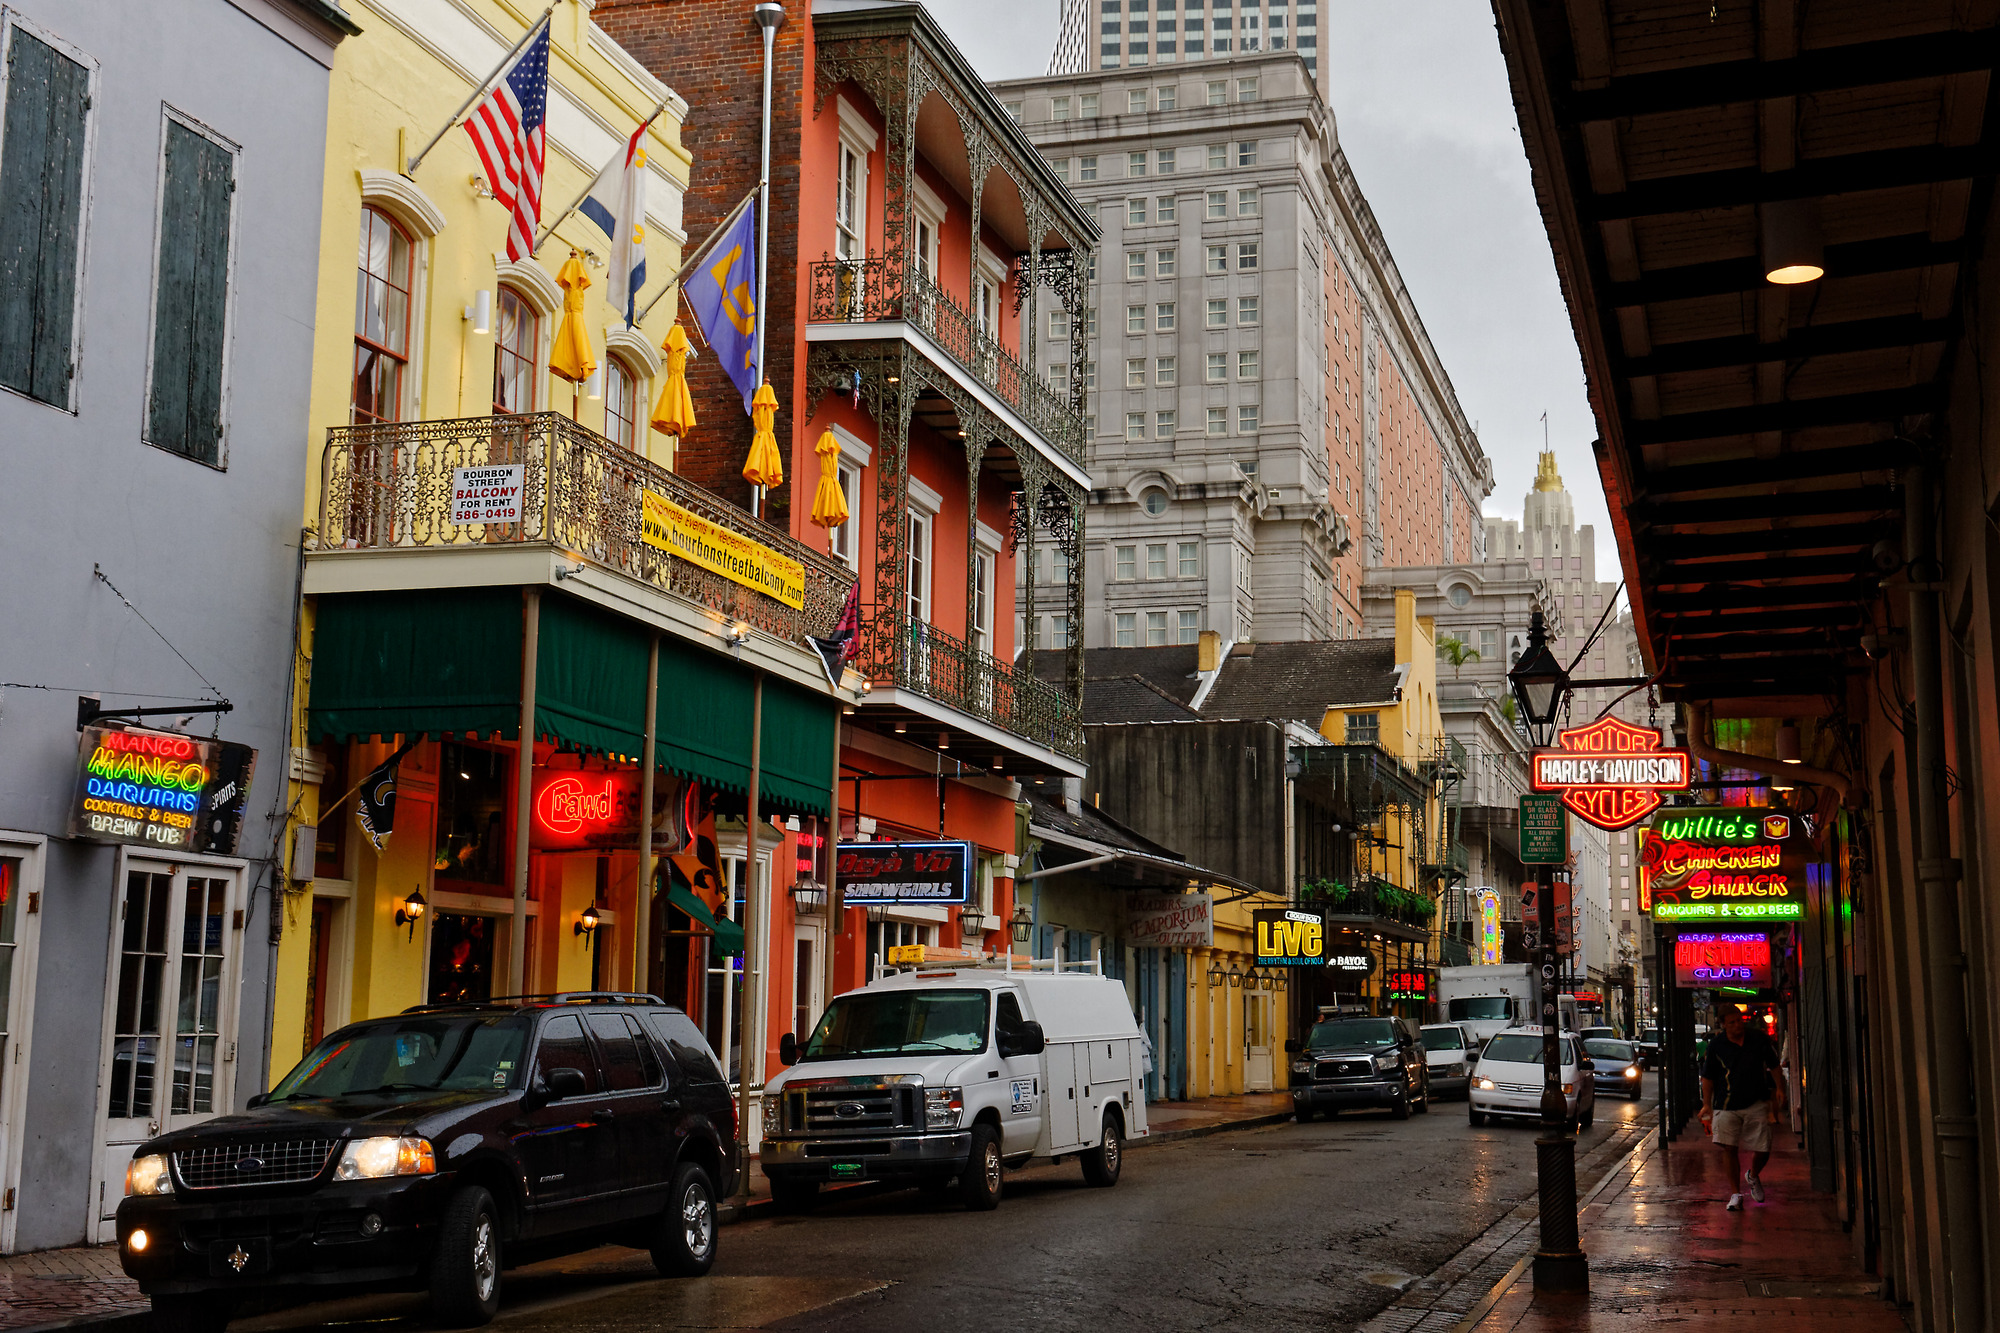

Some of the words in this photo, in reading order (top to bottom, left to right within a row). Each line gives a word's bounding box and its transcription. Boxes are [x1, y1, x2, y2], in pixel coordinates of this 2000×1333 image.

[463, 469, 513, 479] BOURBON
[468, 478, 506, 487] STREET
[456, 486, 518, 499] BALCONY
[461, 500, 480, 508] FOR
[485, 498, 511, 507] RENT
[456, 508, 516, 520] 586-0419
[645, 495, 683, 524] Corporate
[685, 514, 708, 535] Events
[718, 530, 753, 557] Receptions
[764, 551, 783, 571] Private
[785, 563, 803, 581] Parties
[643, 519, 802, 602] www.bourbonstreetbalcony.com
[106, 732, 192, 757] MANGO
[1574, 725, 1646, 751] MOTOR
[87, 747, 206, 792] MANGO
[1541, 759, 1681, 784] HARLEY-DAVIDSON
[87, 778, 198, 812] DAIQUIRIS
[1574, 790, 1647, 819] CYCLES
[84, 797, 144, 820] COCKTAILS
[149, 807, 160, 821] &
[163, 811, 192, 829] BEER
[91, 814, 141, 837] BREW
[145, 824, 183, 845] PUB
[1662, 815, 1757, 840] Willie's
[914, 851, 952, 872] Vu
[1664, 844, 1782, 876] CHICKEN
[845, 882, 952, 897] SHOWGIRLS
[1688, 870, 1789, 900] SHACK
[1129, 902, 1208, 938] EMPORIUM
[1658, 905, 1716, 916] DAIQUIRIS
[1721, 903, 1731, 916] &
[1735, 904, 1766, 916] COLD
[1768, 904, 1800, 915] BEER
[1158, 931, 1206, 944] OUTLET
[1258, 957, 1267, 965] THE
[1268, 957, 1287, 965] RHYTHM
[1292, 957, 1303, 965] SOUL
[1304, 957, 1310, 965] OF
[1311, 957, 1324, 965] NOLA
[1678, 942, 1767, 966] HUSTLER
